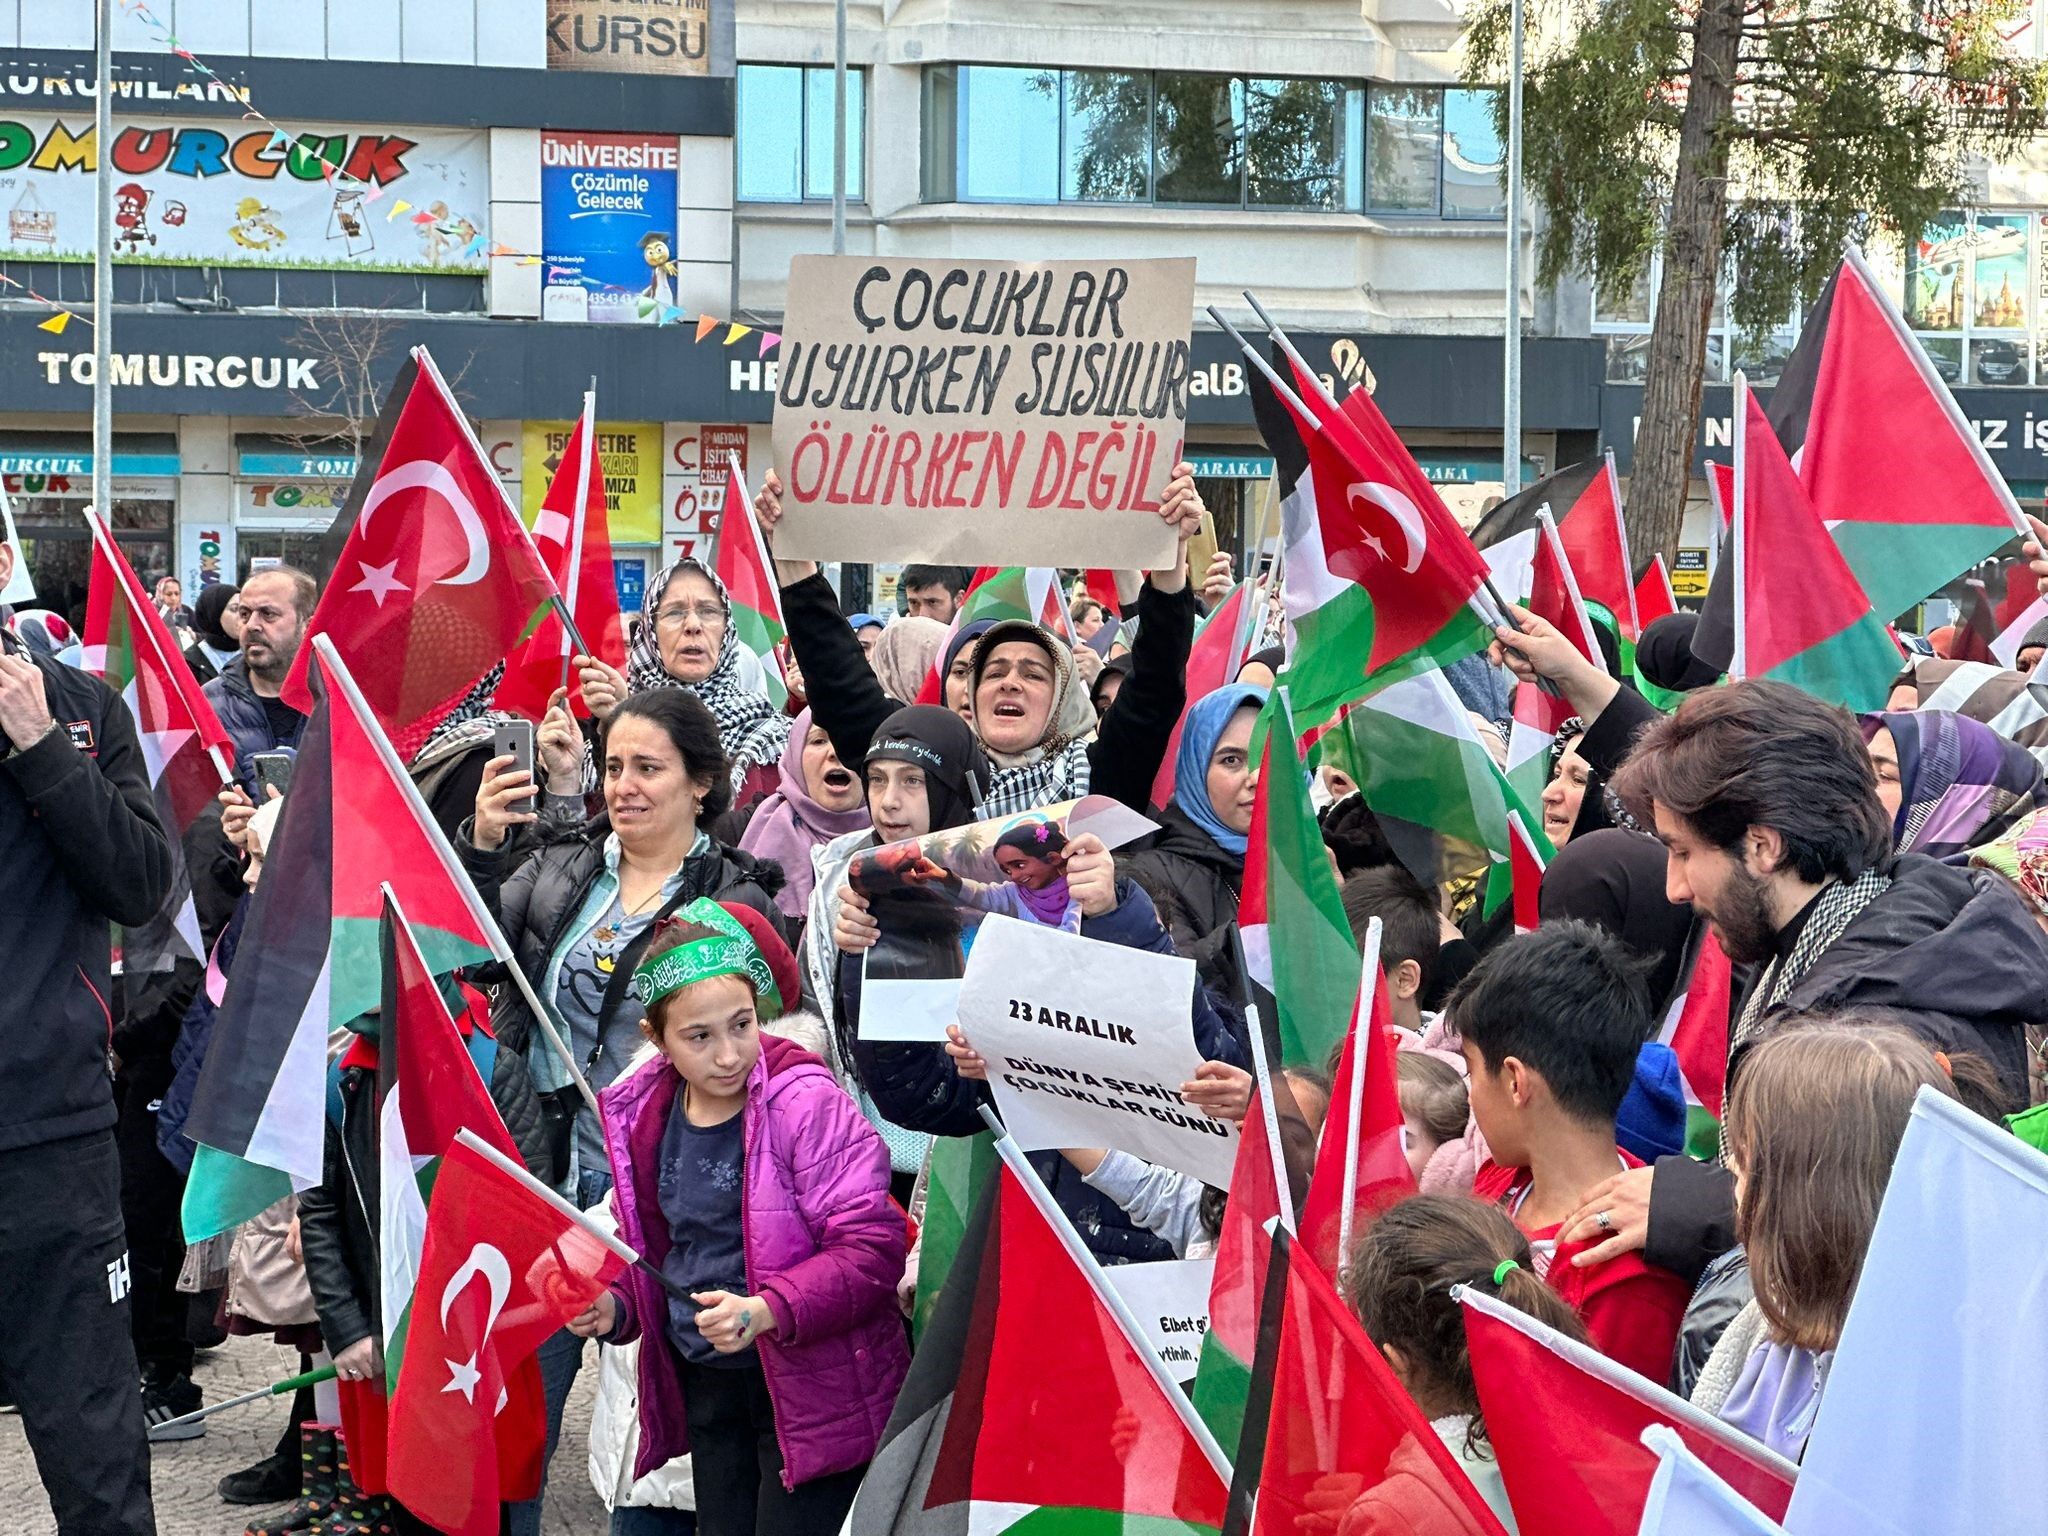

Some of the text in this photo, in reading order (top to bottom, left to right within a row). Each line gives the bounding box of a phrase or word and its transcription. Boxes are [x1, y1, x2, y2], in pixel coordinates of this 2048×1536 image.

[542, 139, 677, 168] ÜNİVERSİTE
[571, 172, 649, 193] Çözümle
[577, 192, 643, 210] Gelecek
[853, 266, 1128, 338] ÇOCUKLAR
[38, 352, 320, 390] TOMURCUK
[779, 339, 1189, 420] UYURKEN SUSULUR
[713, 431, 745, 445] MEYDAN
[791, 420, 1026, 509] ÖLÜRKEN
[1009, 1000, 1137, 1045] 23 ARALIK
[1004, 1057, 1186, 1106] DÜNYA ŞEHİT
[1003, 1073, 1229, 1138] ÇOCUKLAR GÜNÜ
[1160, 1316, 1195, 1333] Elbet
